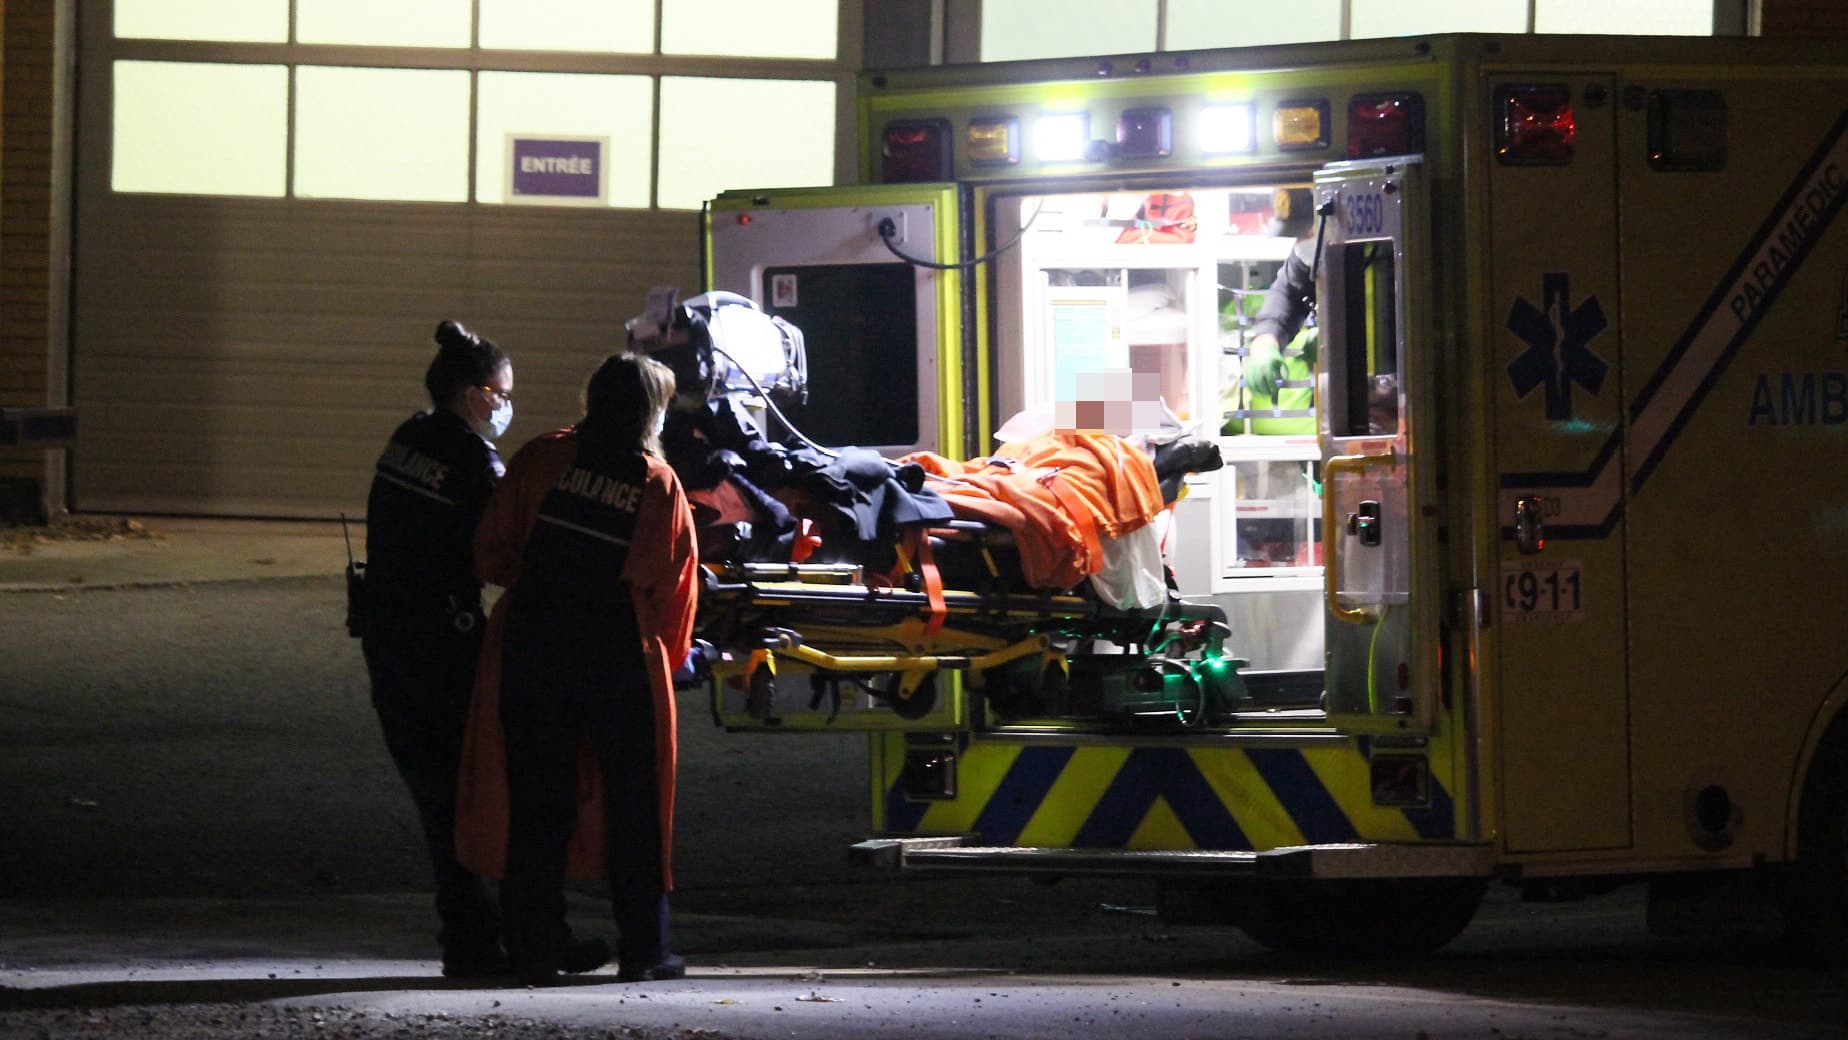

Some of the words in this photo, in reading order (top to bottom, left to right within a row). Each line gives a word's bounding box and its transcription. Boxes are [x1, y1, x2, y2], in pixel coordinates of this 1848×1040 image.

[521, 154, 592, 175] ENTRÉE
[1346, 193, 1383, 233] 3560
[1731, 162, 1842, 322] PARAMEDIC
